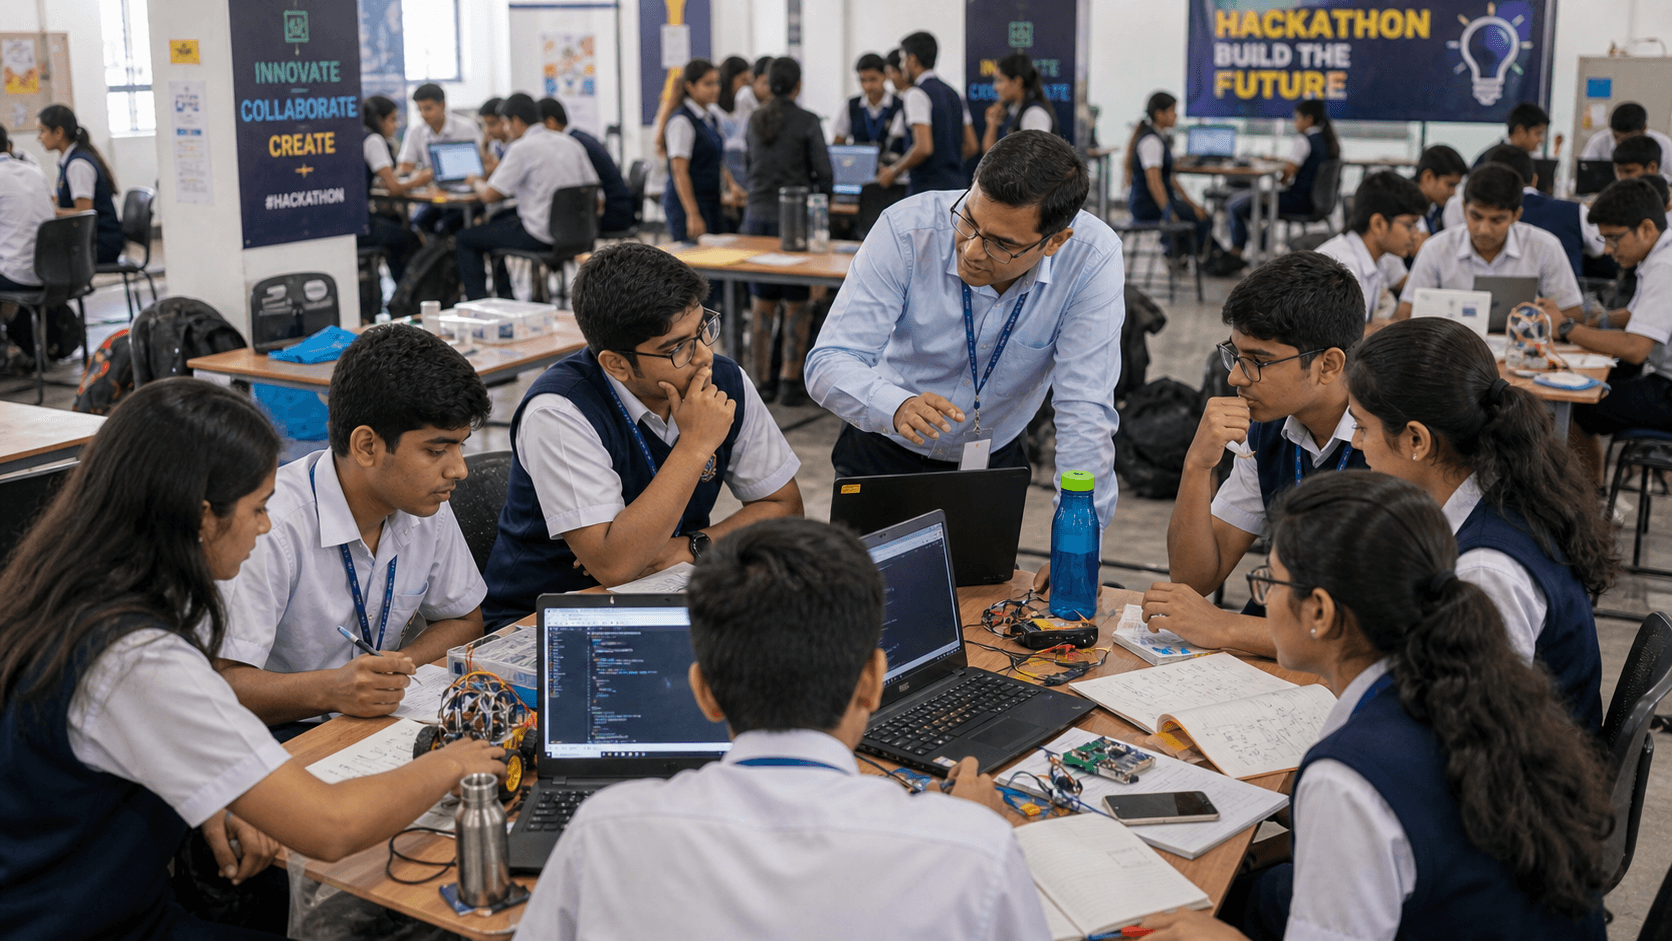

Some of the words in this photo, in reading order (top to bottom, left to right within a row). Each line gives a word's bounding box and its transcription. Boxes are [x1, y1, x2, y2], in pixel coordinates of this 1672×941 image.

[1214, 8, 1431, 39] HACKATHON
[1214, 43, 1293, 68] BUILD
[1296, 43, 1351, 68] THE
[254, 61, 341, 84] INNOVATE
[1214, 70, 1347, 99] FUTURE
[240, 96, 358, 122] COLLABORATE
[269, 132, 336, 157] CREATE
[265, 187, 345, 210] #HACKATHON
